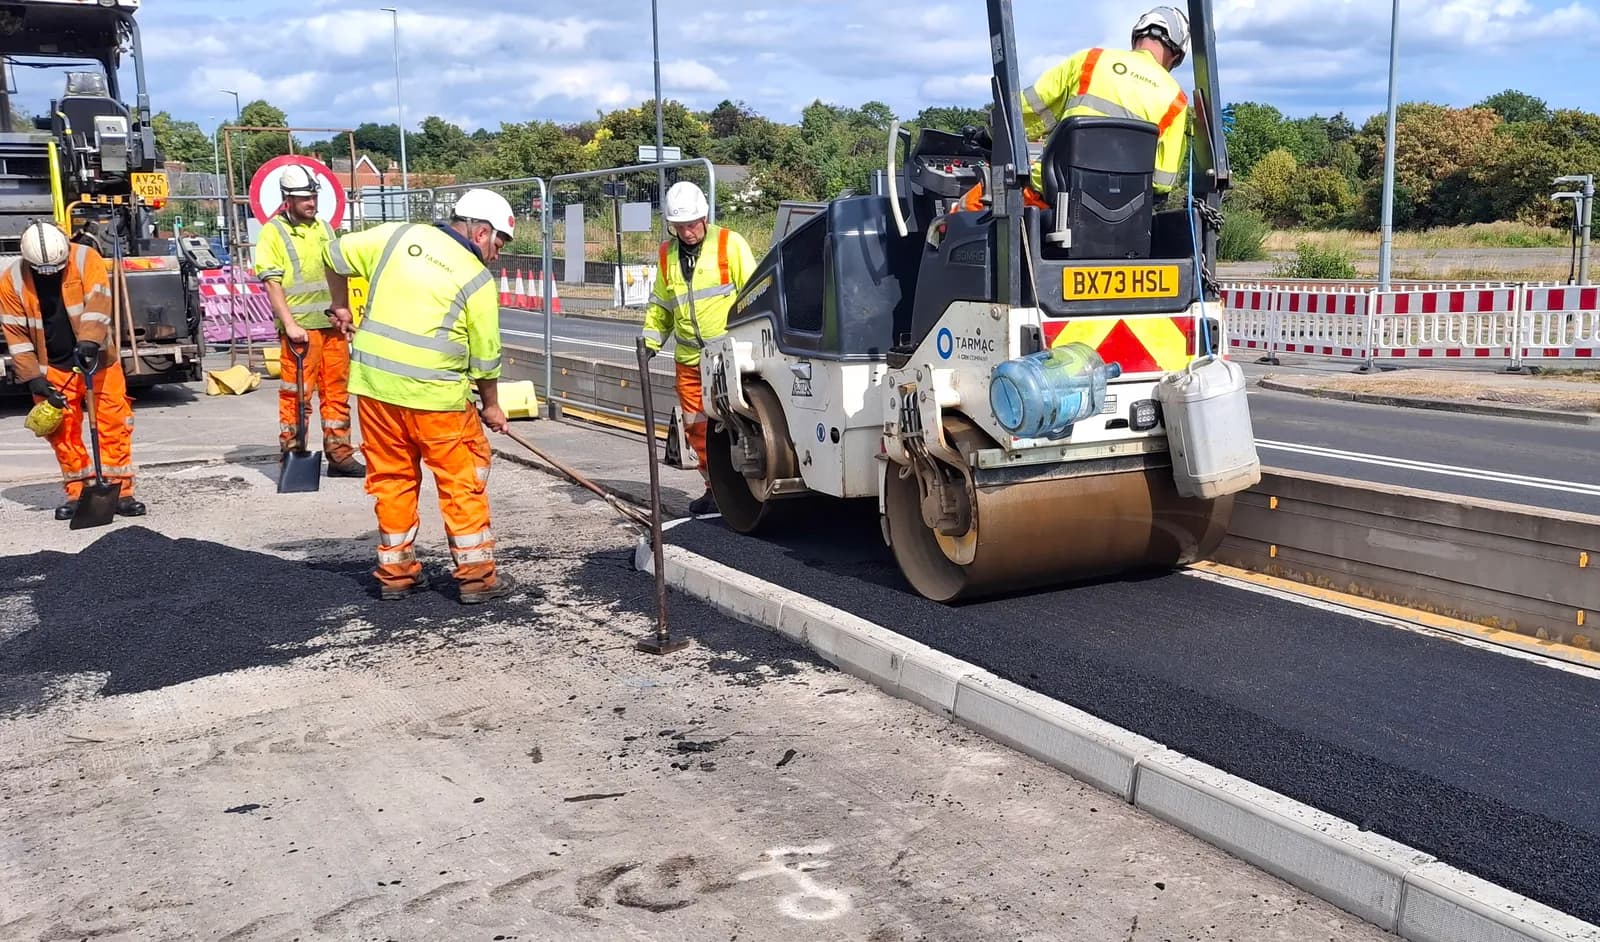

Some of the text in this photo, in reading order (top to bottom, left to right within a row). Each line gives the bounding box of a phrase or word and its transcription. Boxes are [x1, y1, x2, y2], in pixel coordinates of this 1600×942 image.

[140, 185, 162, 195] KBN
[1073, 269, 1170, 295] BX73 HSL
[955, 336, 995, 352] TARMAC
